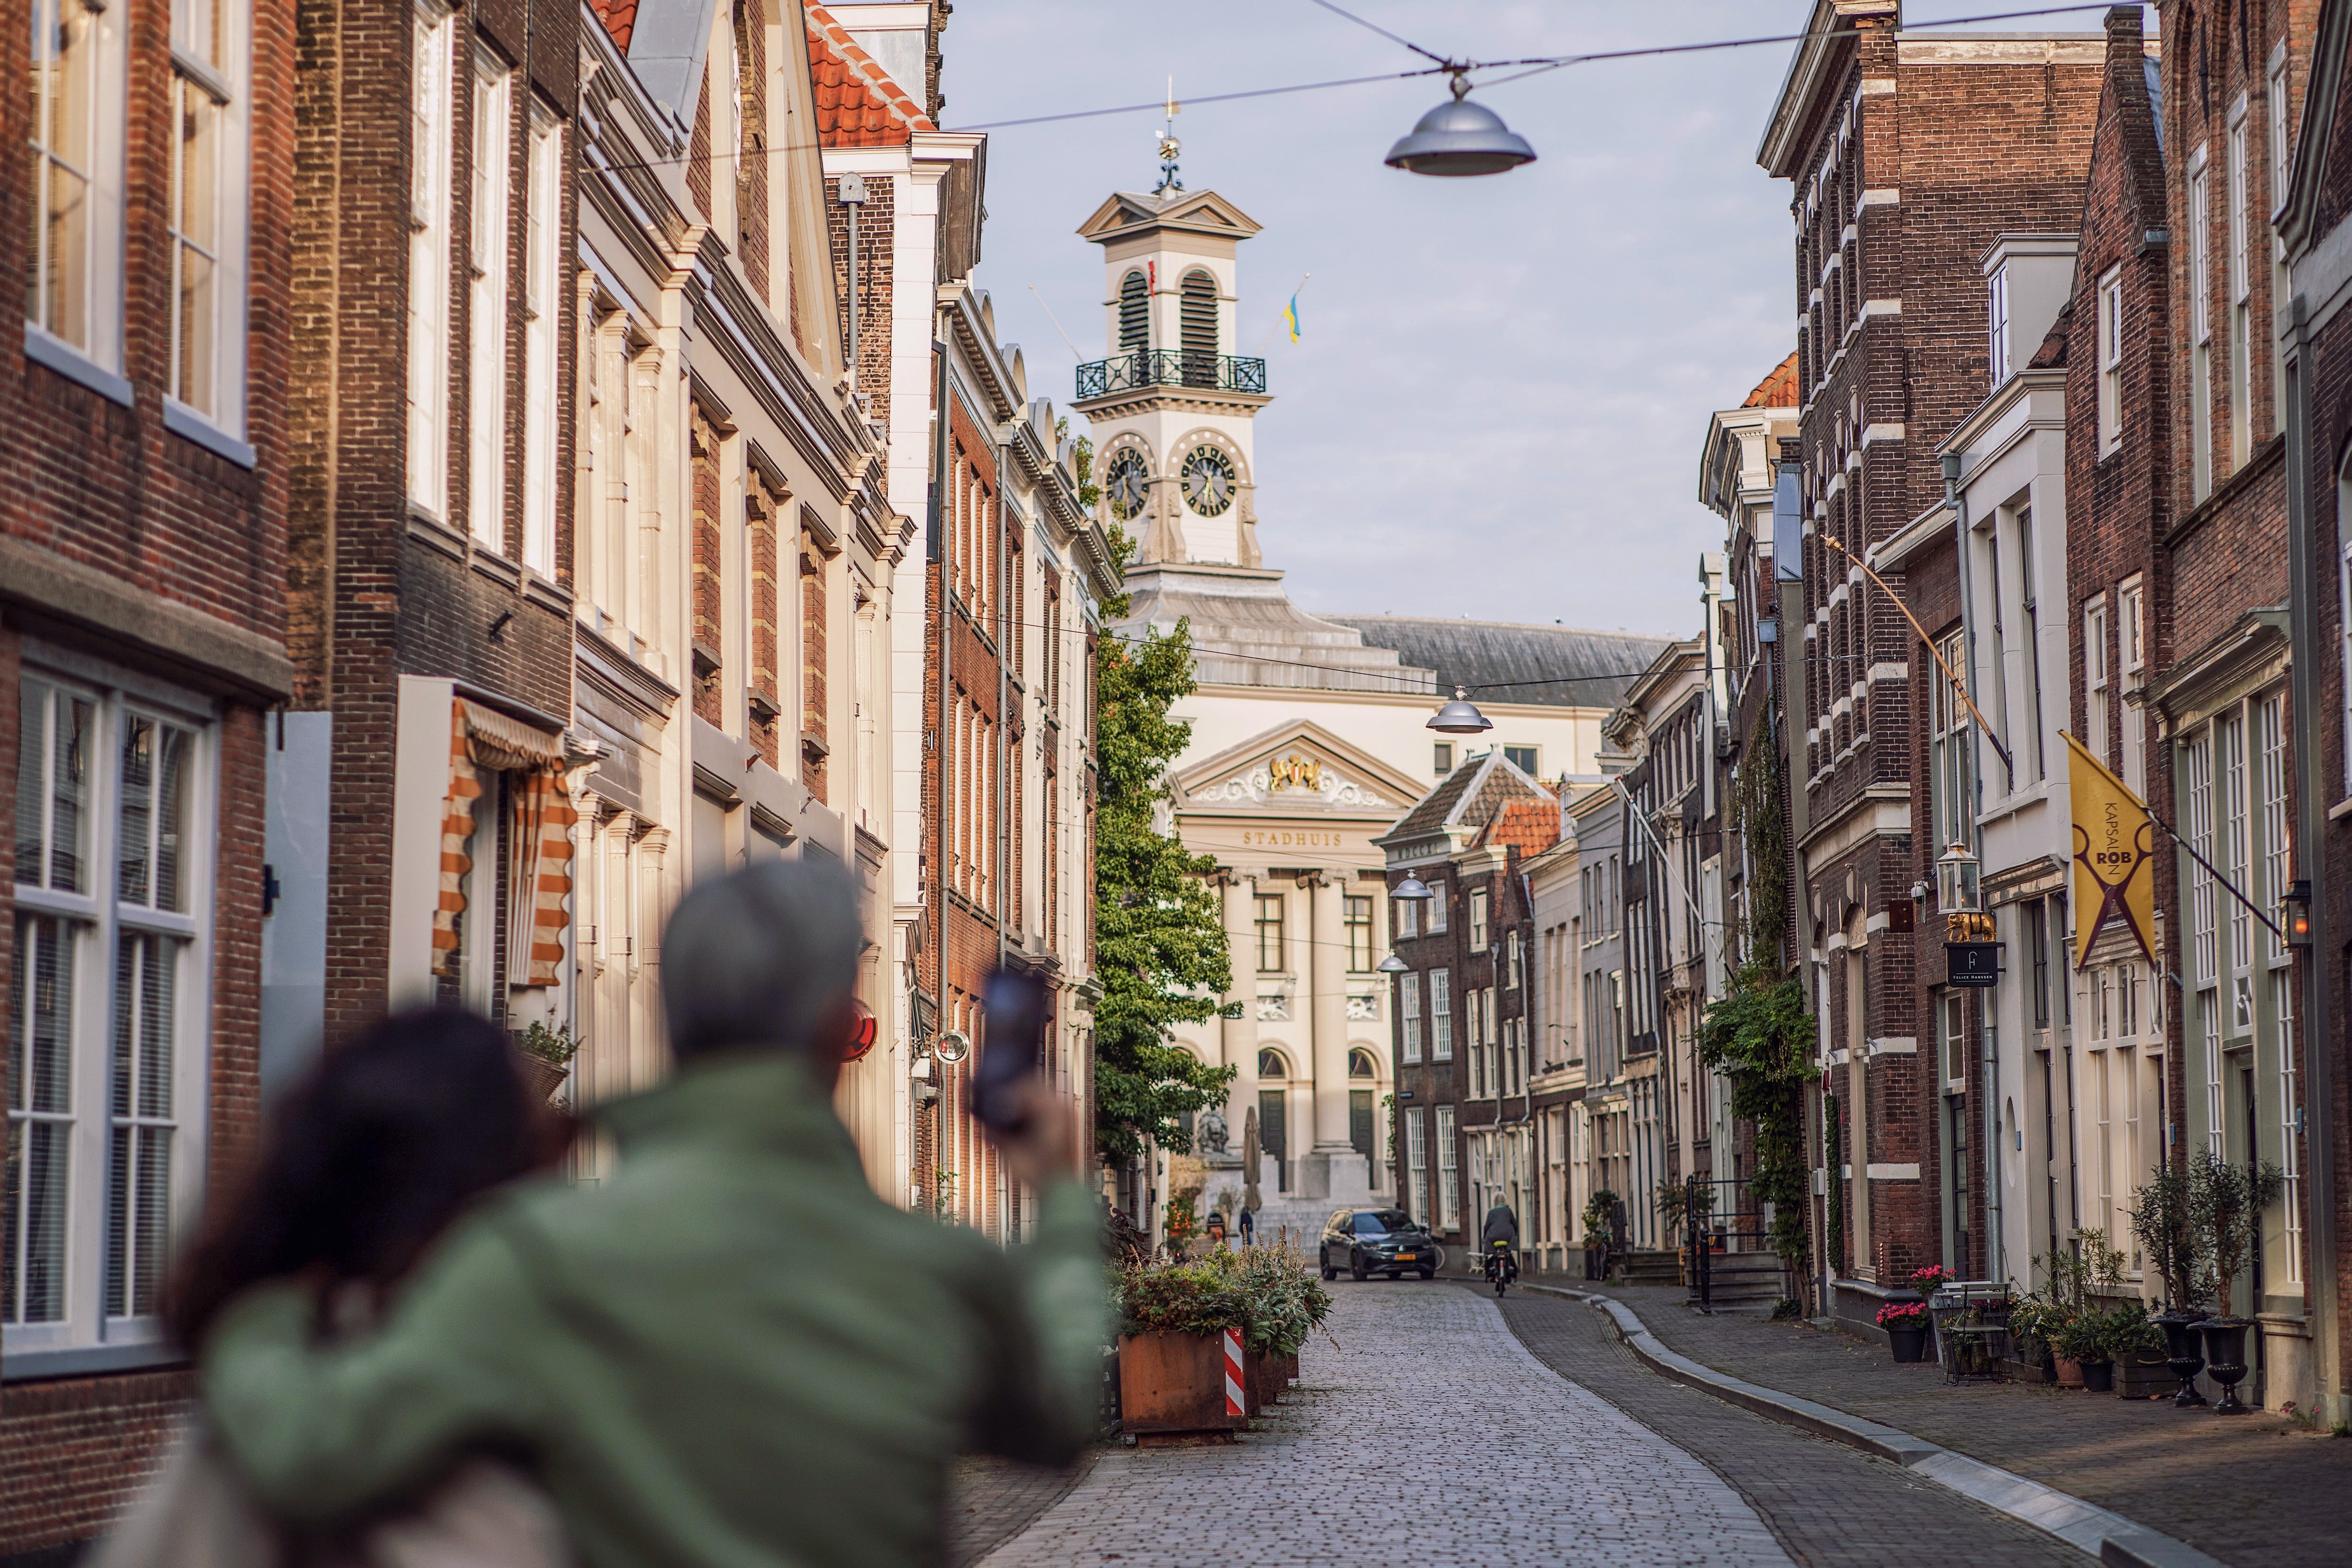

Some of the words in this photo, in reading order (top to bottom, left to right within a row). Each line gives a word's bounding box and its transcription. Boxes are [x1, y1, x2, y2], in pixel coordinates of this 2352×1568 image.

[1243, 831, 1341, 846] STADHUIS
[2105, 803, 2120, 875] KAPSALON
[2097, 852, 2132, 864] ROB
